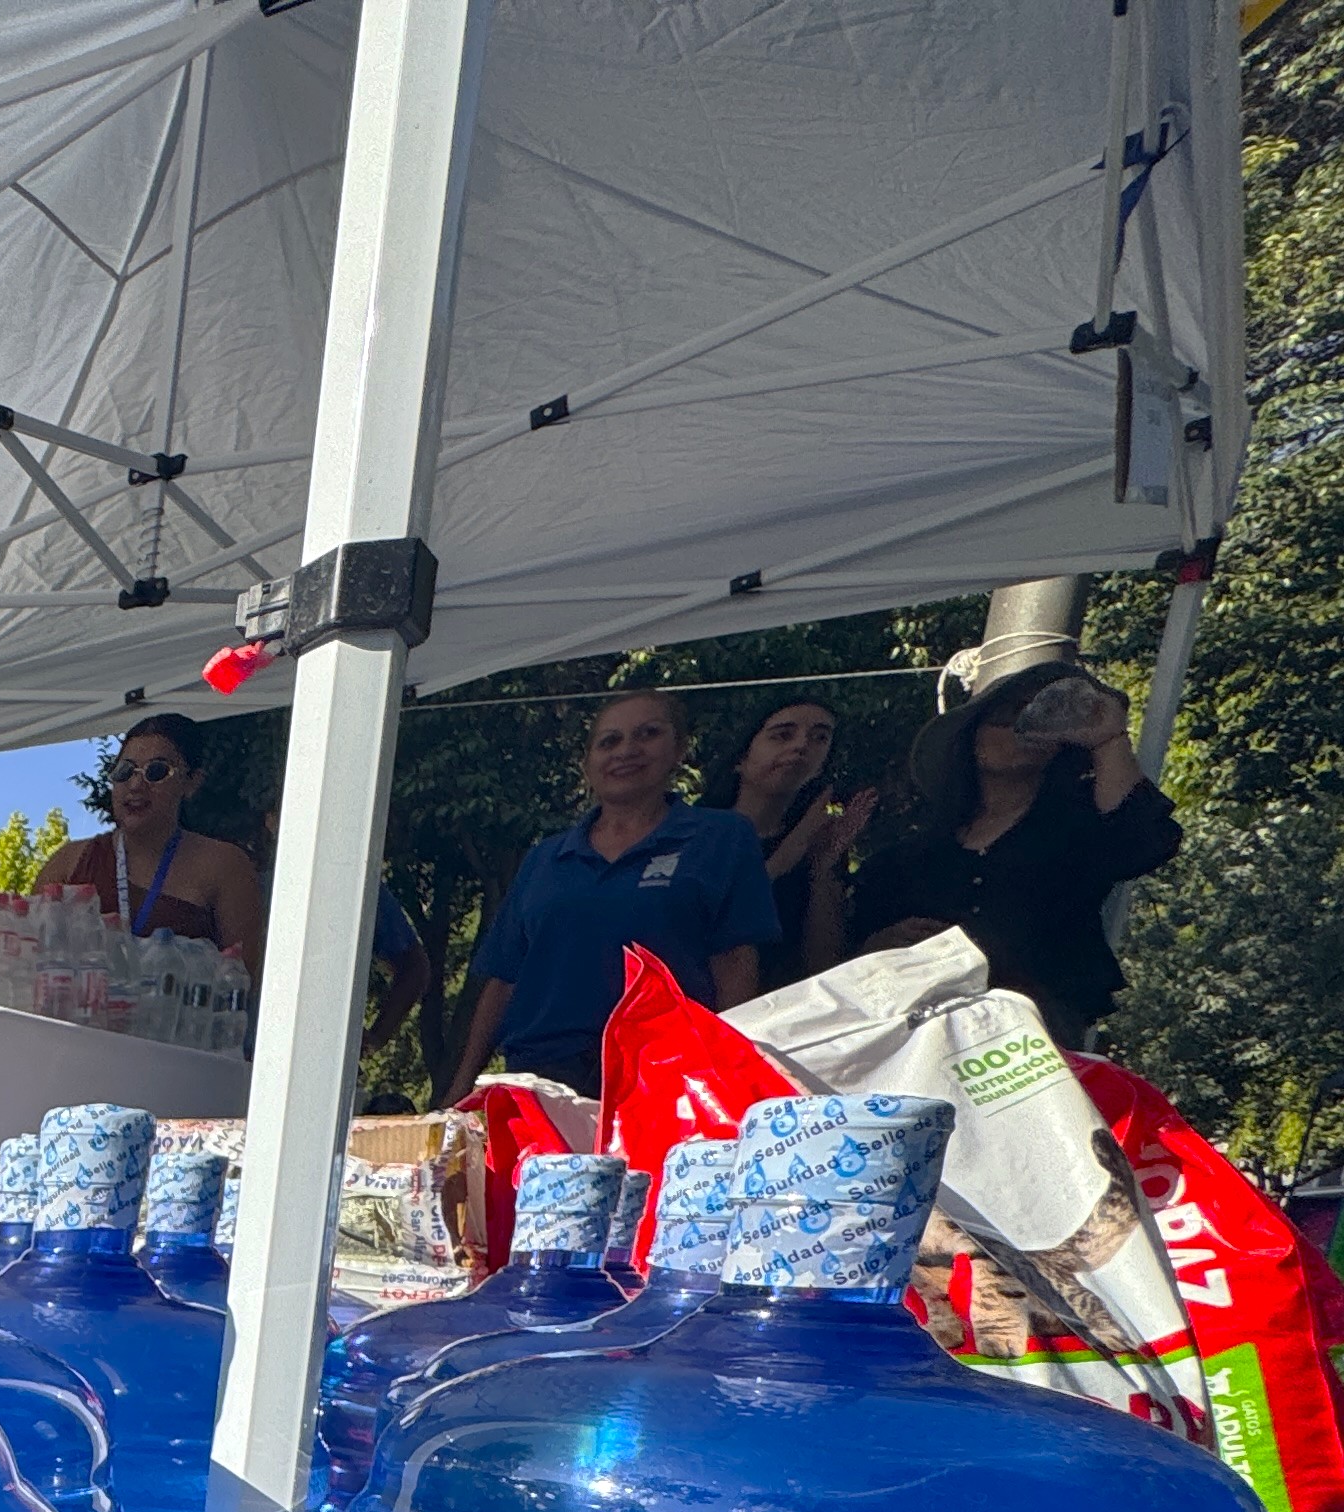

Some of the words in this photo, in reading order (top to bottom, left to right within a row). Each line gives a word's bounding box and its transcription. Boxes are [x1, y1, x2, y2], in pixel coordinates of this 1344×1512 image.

[951, 1033, 1047, 1083] 100%
[964, 1050, 1059, 1097] NUTRICIÓN
[746, 1154, 843, 1203] Seguridad
[855, 1127, 906, 1156] Sello
[913, 1115, 932, 1131] de
[753, 1110, 848, 1162] Seguridad
[742, 1199, 834, 1246] Seguridad
[848, 1173, 898, 1202] Sello
[901, 1161, 920, 1177] de
[733, 1240, 826, 1286] Seguridad
[841, 1217, 888, 1243] Sello
[893, 1204, 913, 1221] de
[832, 1257, 881, 1287] Sello
[1240, 1397, 1263, 1437] GATOS
